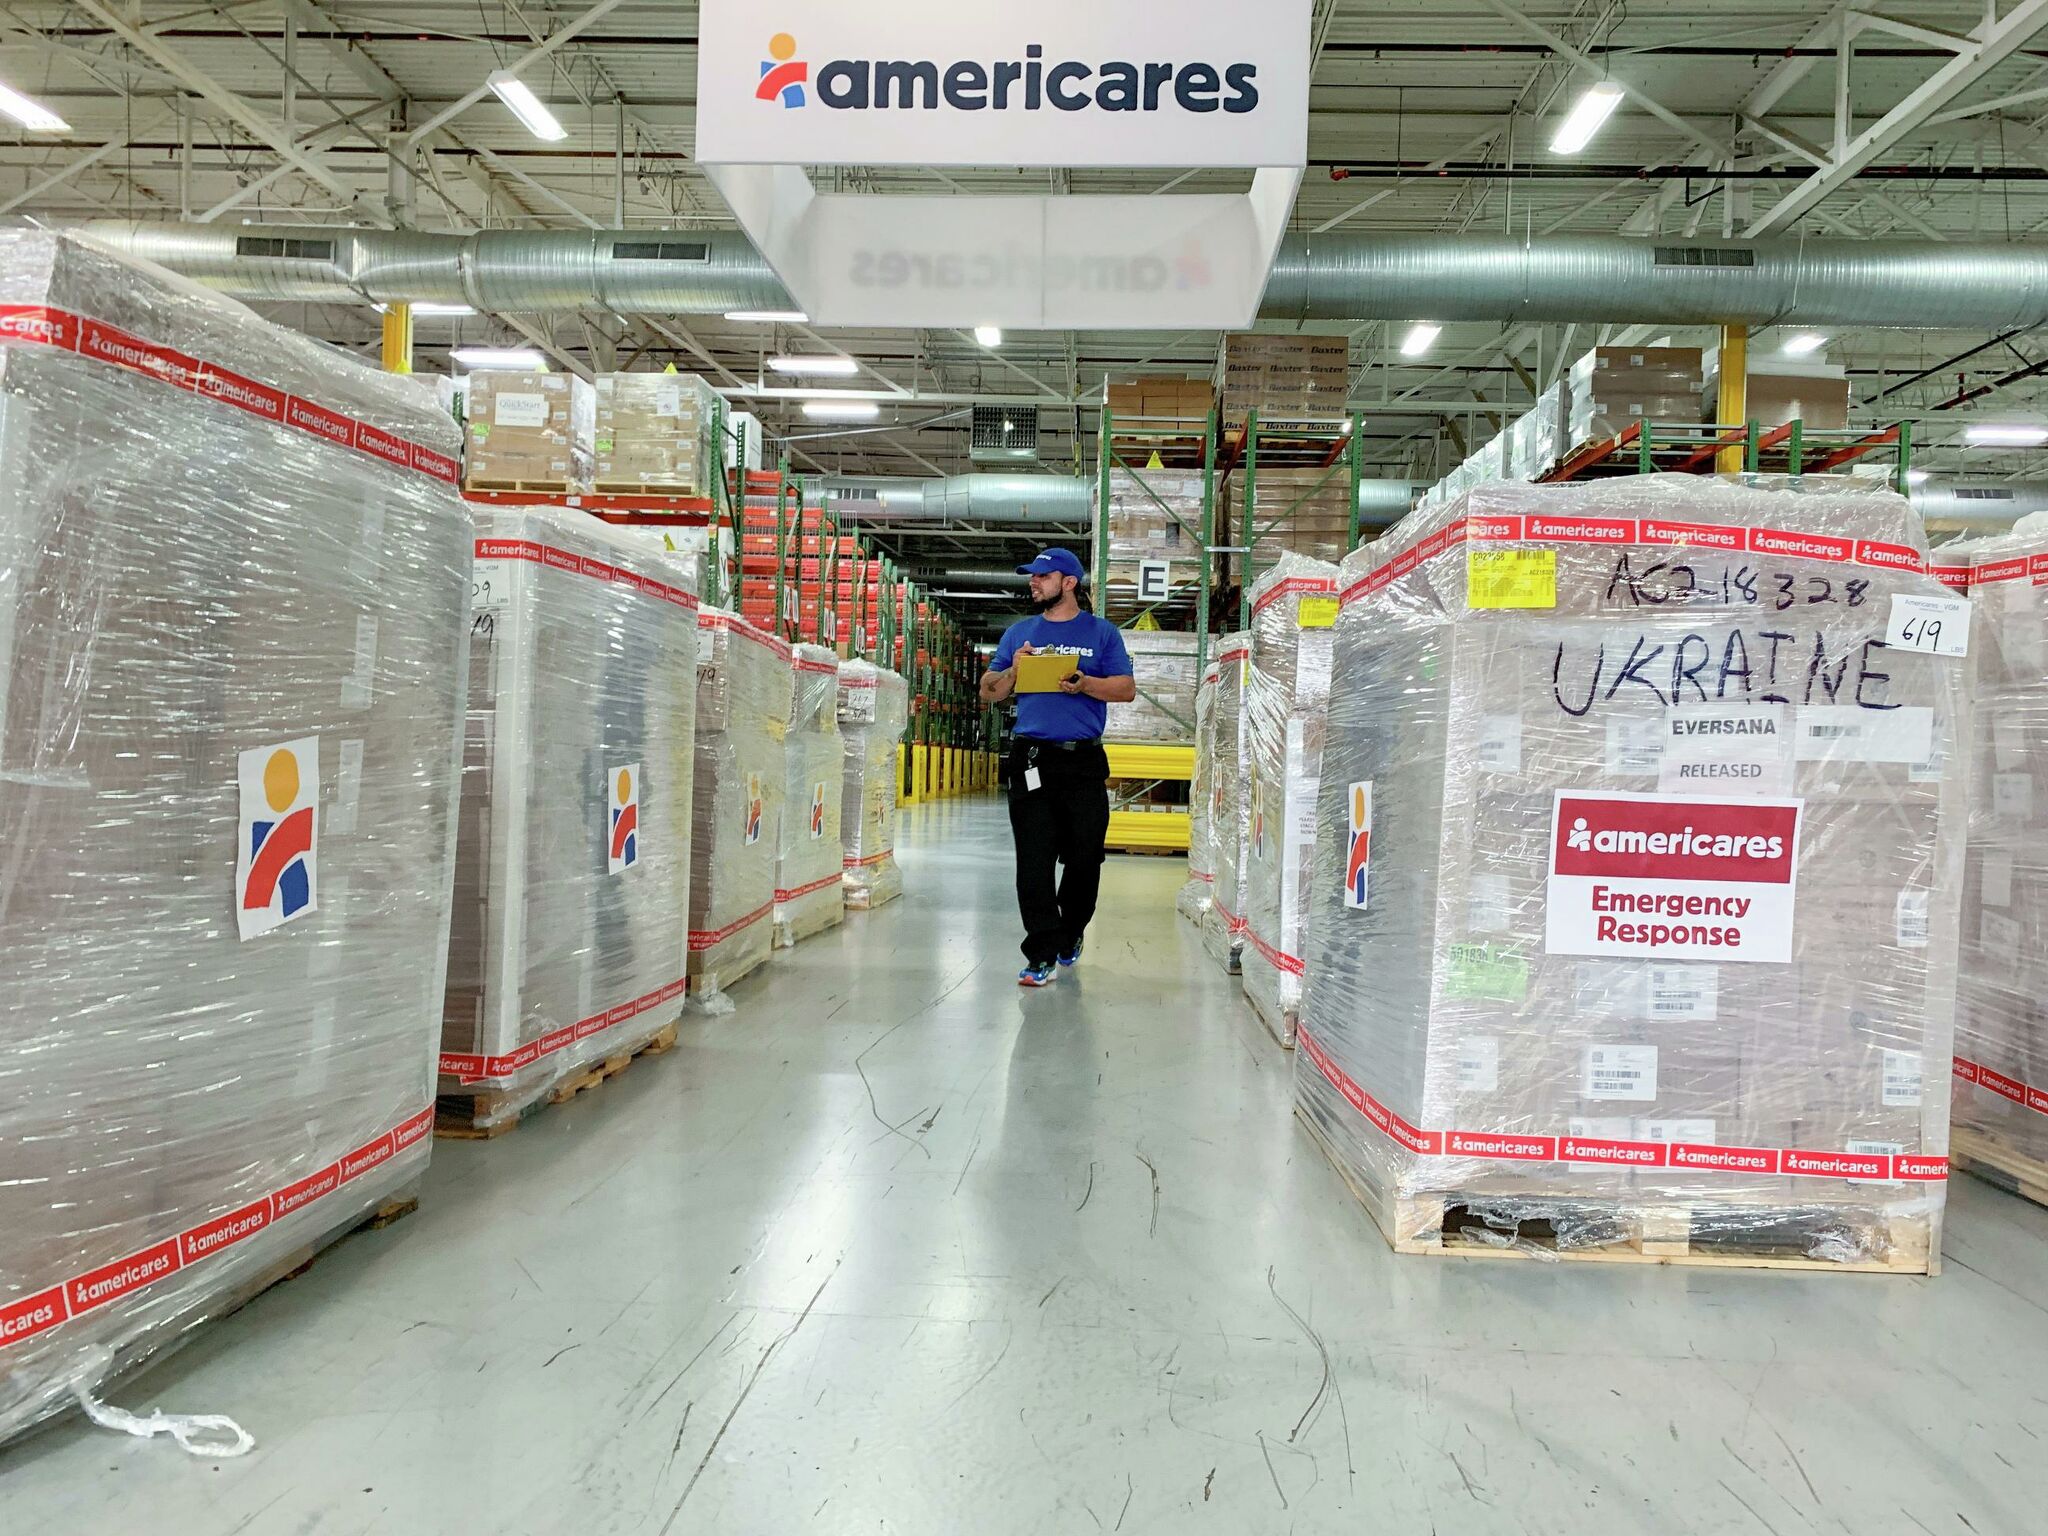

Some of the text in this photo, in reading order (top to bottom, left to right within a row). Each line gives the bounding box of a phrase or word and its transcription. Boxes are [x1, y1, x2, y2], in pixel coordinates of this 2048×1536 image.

[816, 44, 1259, 113] americares
[1311, 346, 1344, 354] Baxter
[1228, 364, 1261, 372] Baxter
[1310, 365, 1344, 373] Baxter
[299, 410, 349, 440] americares
[1265, 422, 1299, 430] Baxter
[1541, 520, 1625, 539] americares
[1656, 527, 1736, 545] americares
[1765, 534, 1843, 557] americares
[1143, 566, 1166, 596] E
[1902, 617, 1942, 652] 619
[1553, 629, 1902, 716] UKRAINE
[1672, 719, 1776, 736] EVERSANA
[1680, 763, 1762, 778] RELEASED
[1593, 826, 1784, 859] americares
[1592, 885, 1752, 919] Emergency
[1597, 916, 1741, 947] Response
[1394, 1122, 1431, 1150] americares
[1462, 1139, 1544, 1156] americares
[1574, 1145, 1655, 1161] americares
[1686, 1152, 1767, 1168] americares
[1797, 1158, 1879, 1175] americares
[89, 1253, 170, 1300] americares
[197, 1209, 264, 1251] americares
[285, 1173, 335, 1210] americares
[350, 1143, 390, 1174] americares
